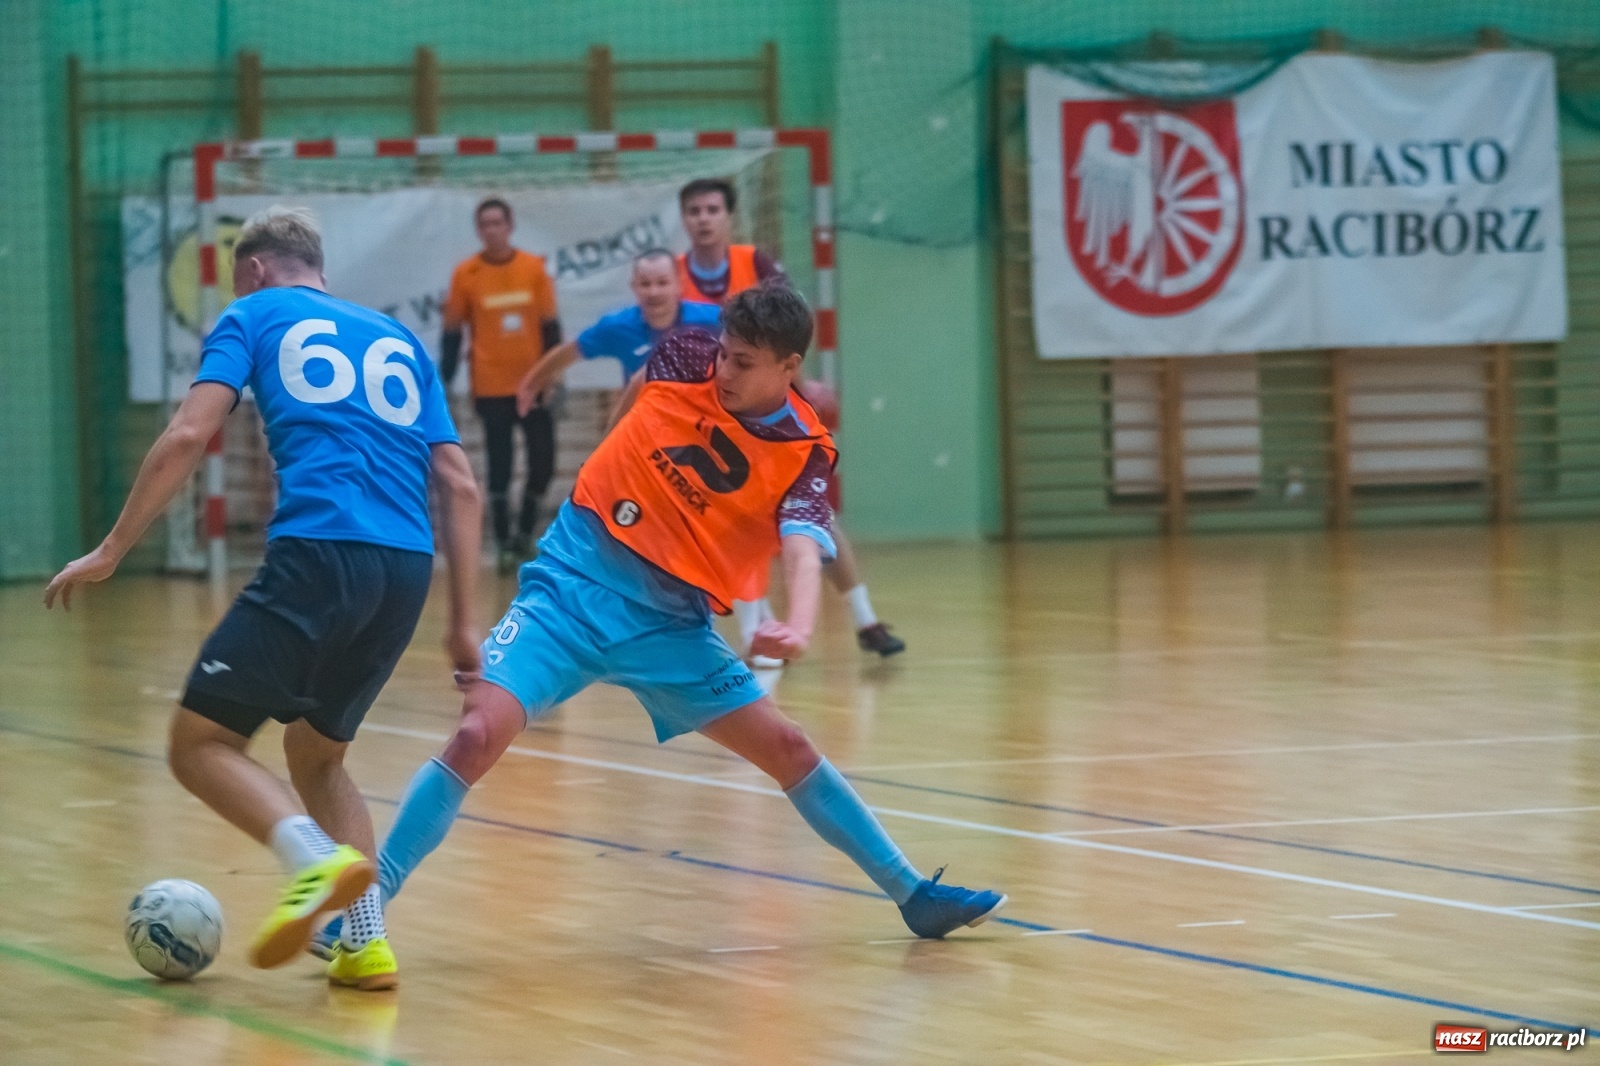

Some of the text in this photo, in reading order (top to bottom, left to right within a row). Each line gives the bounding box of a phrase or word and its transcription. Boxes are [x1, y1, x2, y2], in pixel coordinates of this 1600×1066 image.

[1288, 137, 1510, 189] MIASTO
[1258, 197, 1546, 262] RACIBÓRZ
[278, 318, 422, 427] 66
[615, 500, 640, 526] 6
[647, 448, 713, 516] PATRICK
